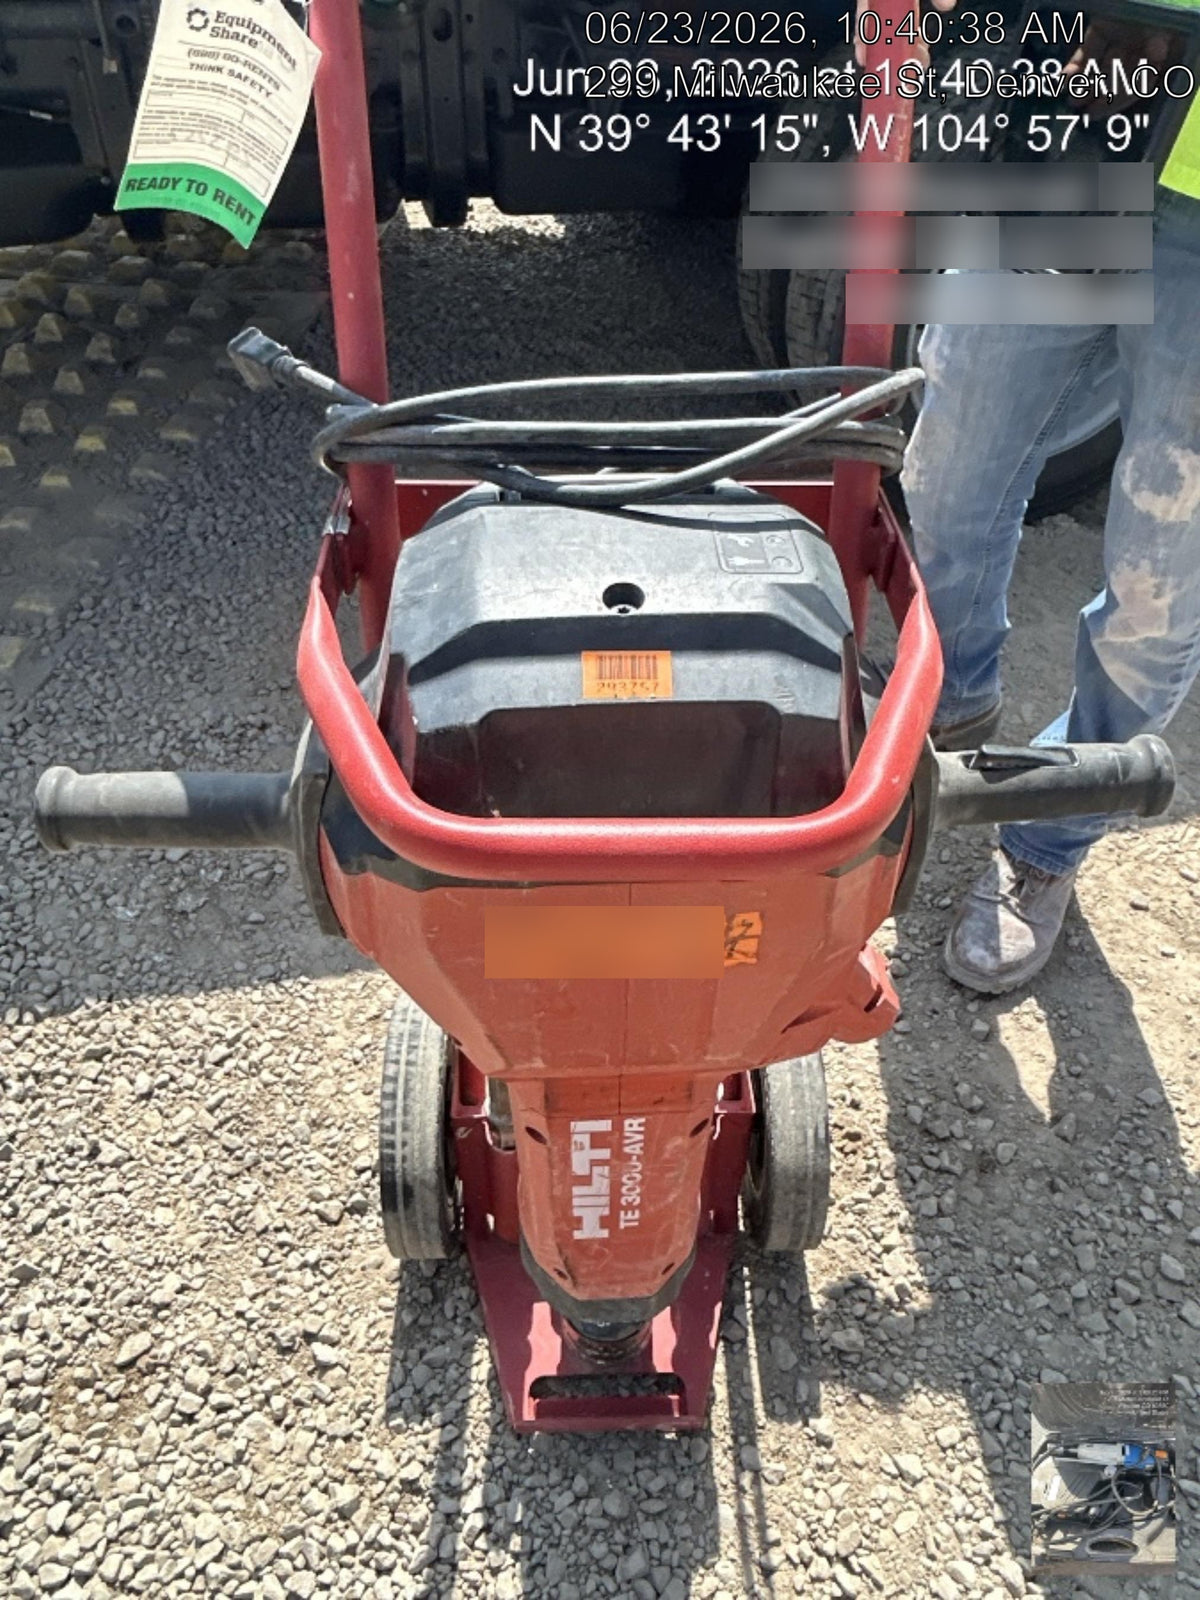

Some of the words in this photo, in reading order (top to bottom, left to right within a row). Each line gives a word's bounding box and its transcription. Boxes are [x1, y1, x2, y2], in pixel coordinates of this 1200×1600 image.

[208, 26, 259, 50] Share
[214, 10, 299, 70] Equipment
[188, 62, 224, 75] THINK
[227, 67, 273, 99] SAFETY
[124, 176, 183, 194] READY
[186, 178, 208, 197] TO
[212, 187, 256, 226] RENT
[569, 1118, 612, 1240] HILTI
[619, 1209, 641, 1230] TE
